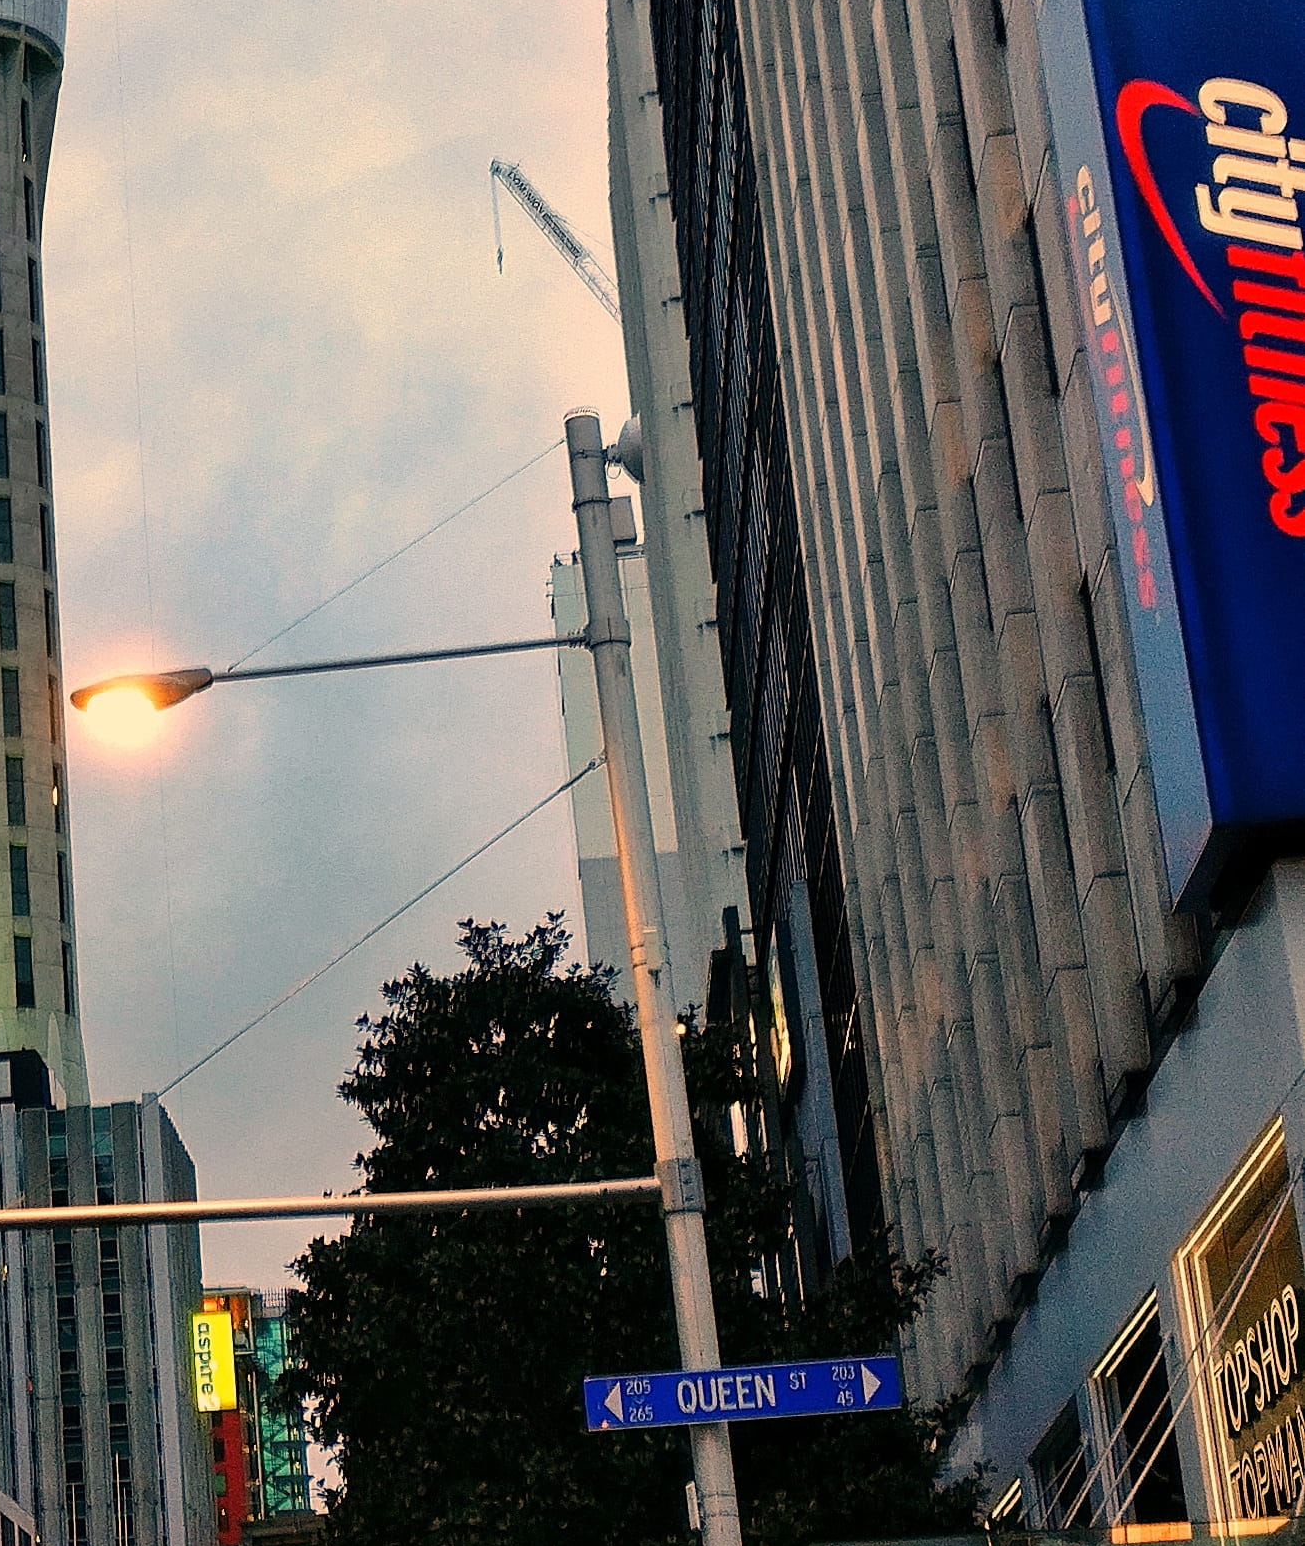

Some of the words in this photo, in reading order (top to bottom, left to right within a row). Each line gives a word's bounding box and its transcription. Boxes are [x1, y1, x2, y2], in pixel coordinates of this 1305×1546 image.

[676, 1372, 777, 1415] QUEEN
[788, 1371, 808, 1391] ST
[1213, 1283, 1300, 1440] TOPSHOP
